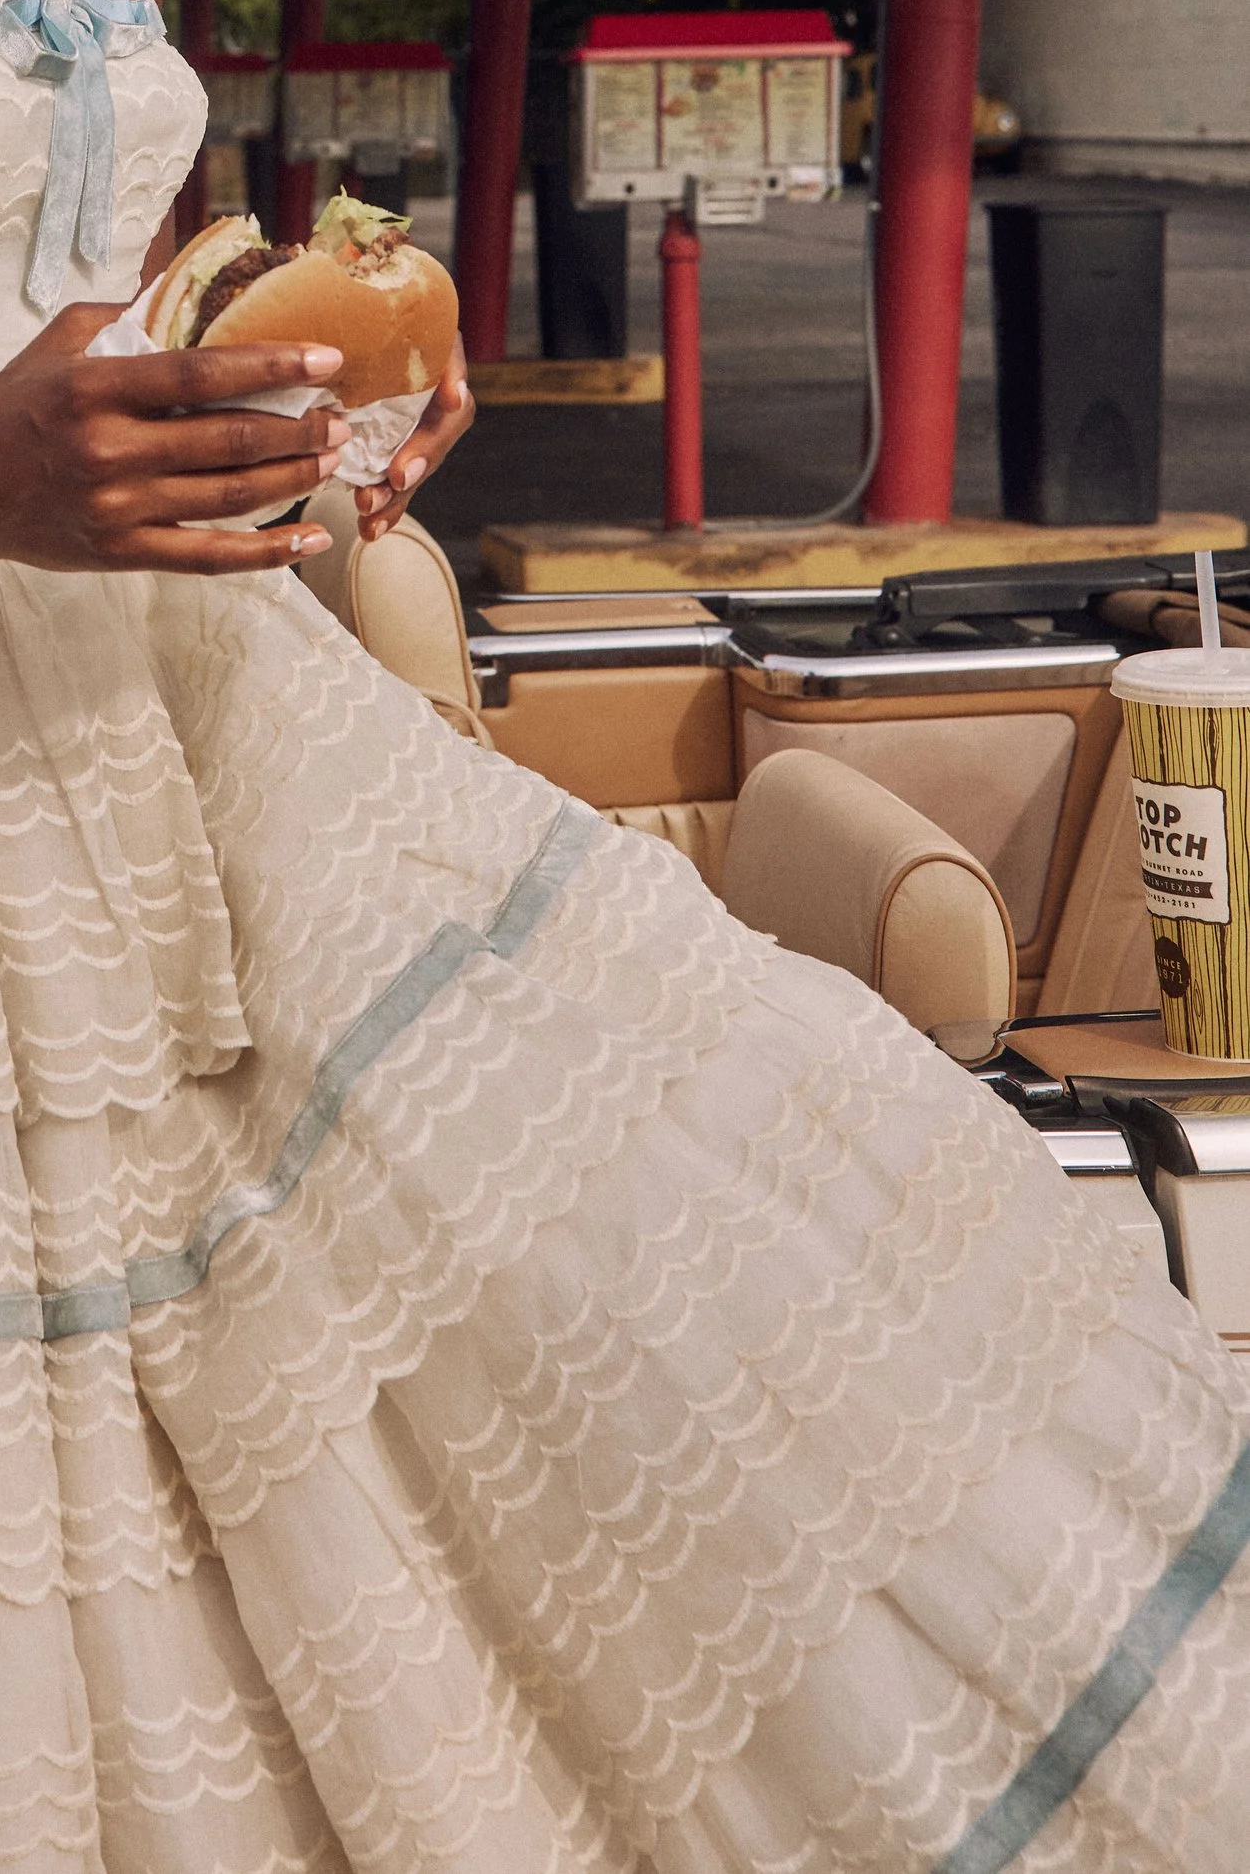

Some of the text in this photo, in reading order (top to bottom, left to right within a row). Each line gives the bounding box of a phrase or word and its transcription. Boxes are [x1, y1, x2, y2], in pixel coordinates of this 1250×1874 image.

[1135, 795, 1181, 828] TOP
[1140, 824, 1208, 861] OTCH
[1175, 868, 1204, 877] ROAD
[1157, 955, 1181, 970] SINCE
[1159, 967, 1183, 984] 1971
